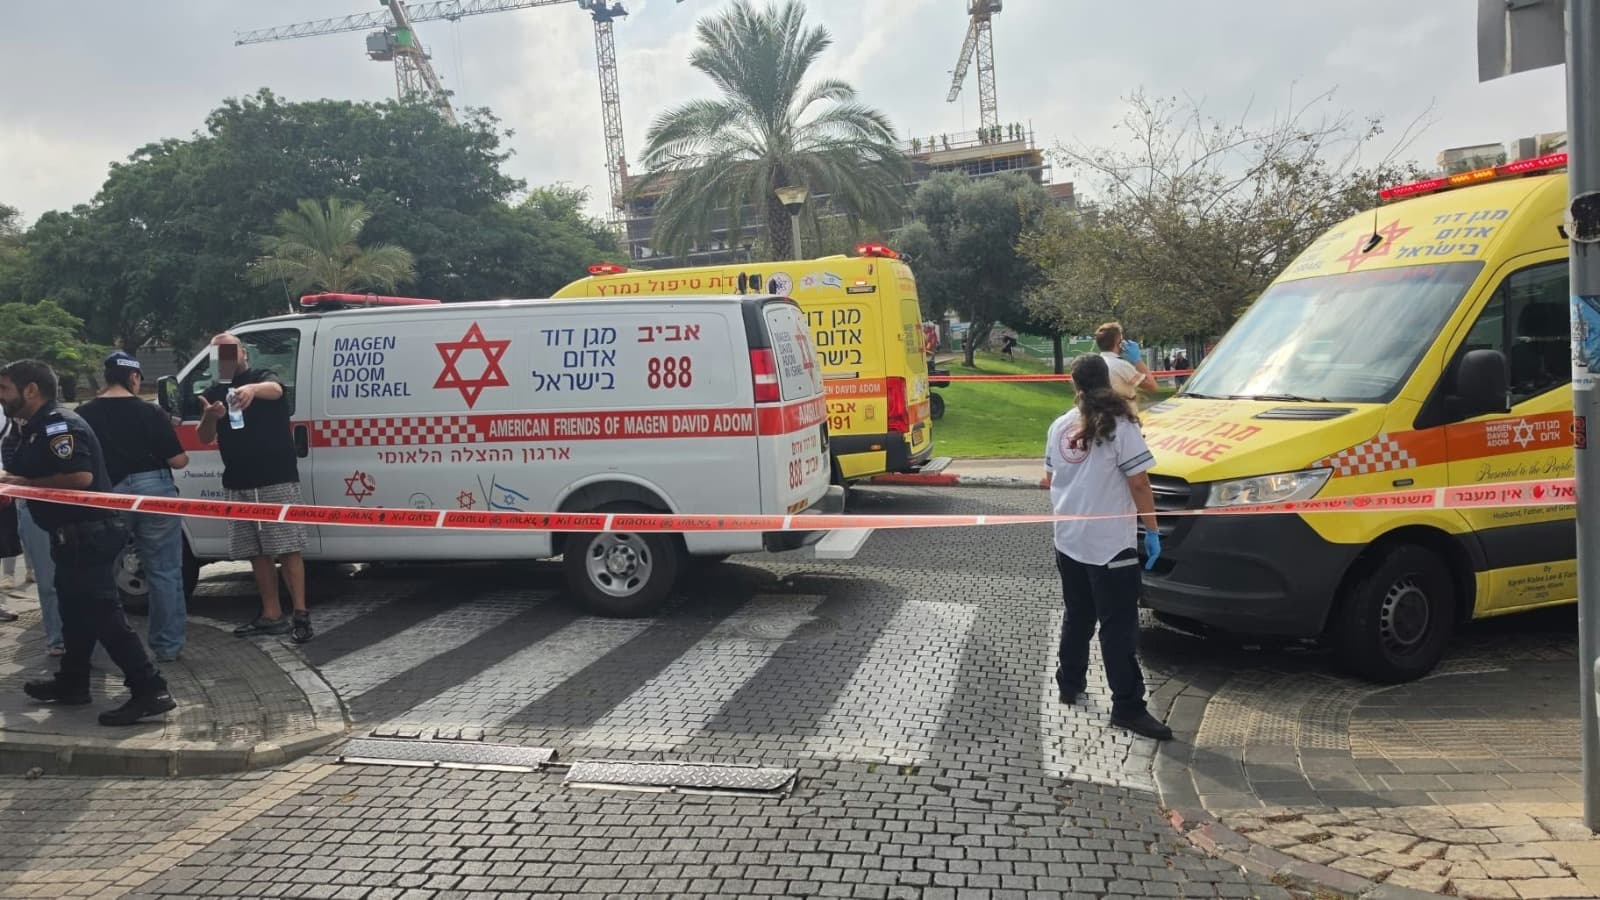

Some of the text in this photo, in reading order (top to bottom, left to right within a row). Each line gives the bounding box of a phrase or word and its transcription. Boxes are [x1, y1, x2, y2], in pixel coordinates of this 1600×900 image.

[1432, 208, 1509, 226] מגן דוד
[1435, 226, 1497, 240] אדום
[1395, 241, 1480, 260] בישראל
[596, 282, 640, 297] נמרץ
[648, 278, 701, 293] טיפול
[807, 308, 862, 329] מגן דו
[540, 327, 617, 348] מגן דוד
[637, 324, 700, 343] אביב
[816, 328, 862, 347] אדום
[334, 336, 396, 352] MAGEN
[332, 351, 385, 368] DAVID
[563, 349, 616, 368] אדום
[816, 348, 863, 367] בישר
[332, 367, 385, 383] ADOM
[532, 370, 616, 392] בישראל
[647, 355, 693, 390] 888
[331, 381, 412, 399] IN ISRAEL
[835, 384, 857, 395] DAVID
[859, 383, 881, 393] ADOM
[488, 412, 752, 438] AMERICAN FRIENDS OF MAGEN DAVID ADOM
[1486, 432, 1509, 440] DAVID
[1487, 439, 1510, 448] ADOM
[377, 446, 571, 464] ארגון ההצלה הלאומי
[789, 457, 803, 490] 888
[1375, 494, 1433, 506] משטרת
[1455, 488, 1522, 502] אין מעבר
